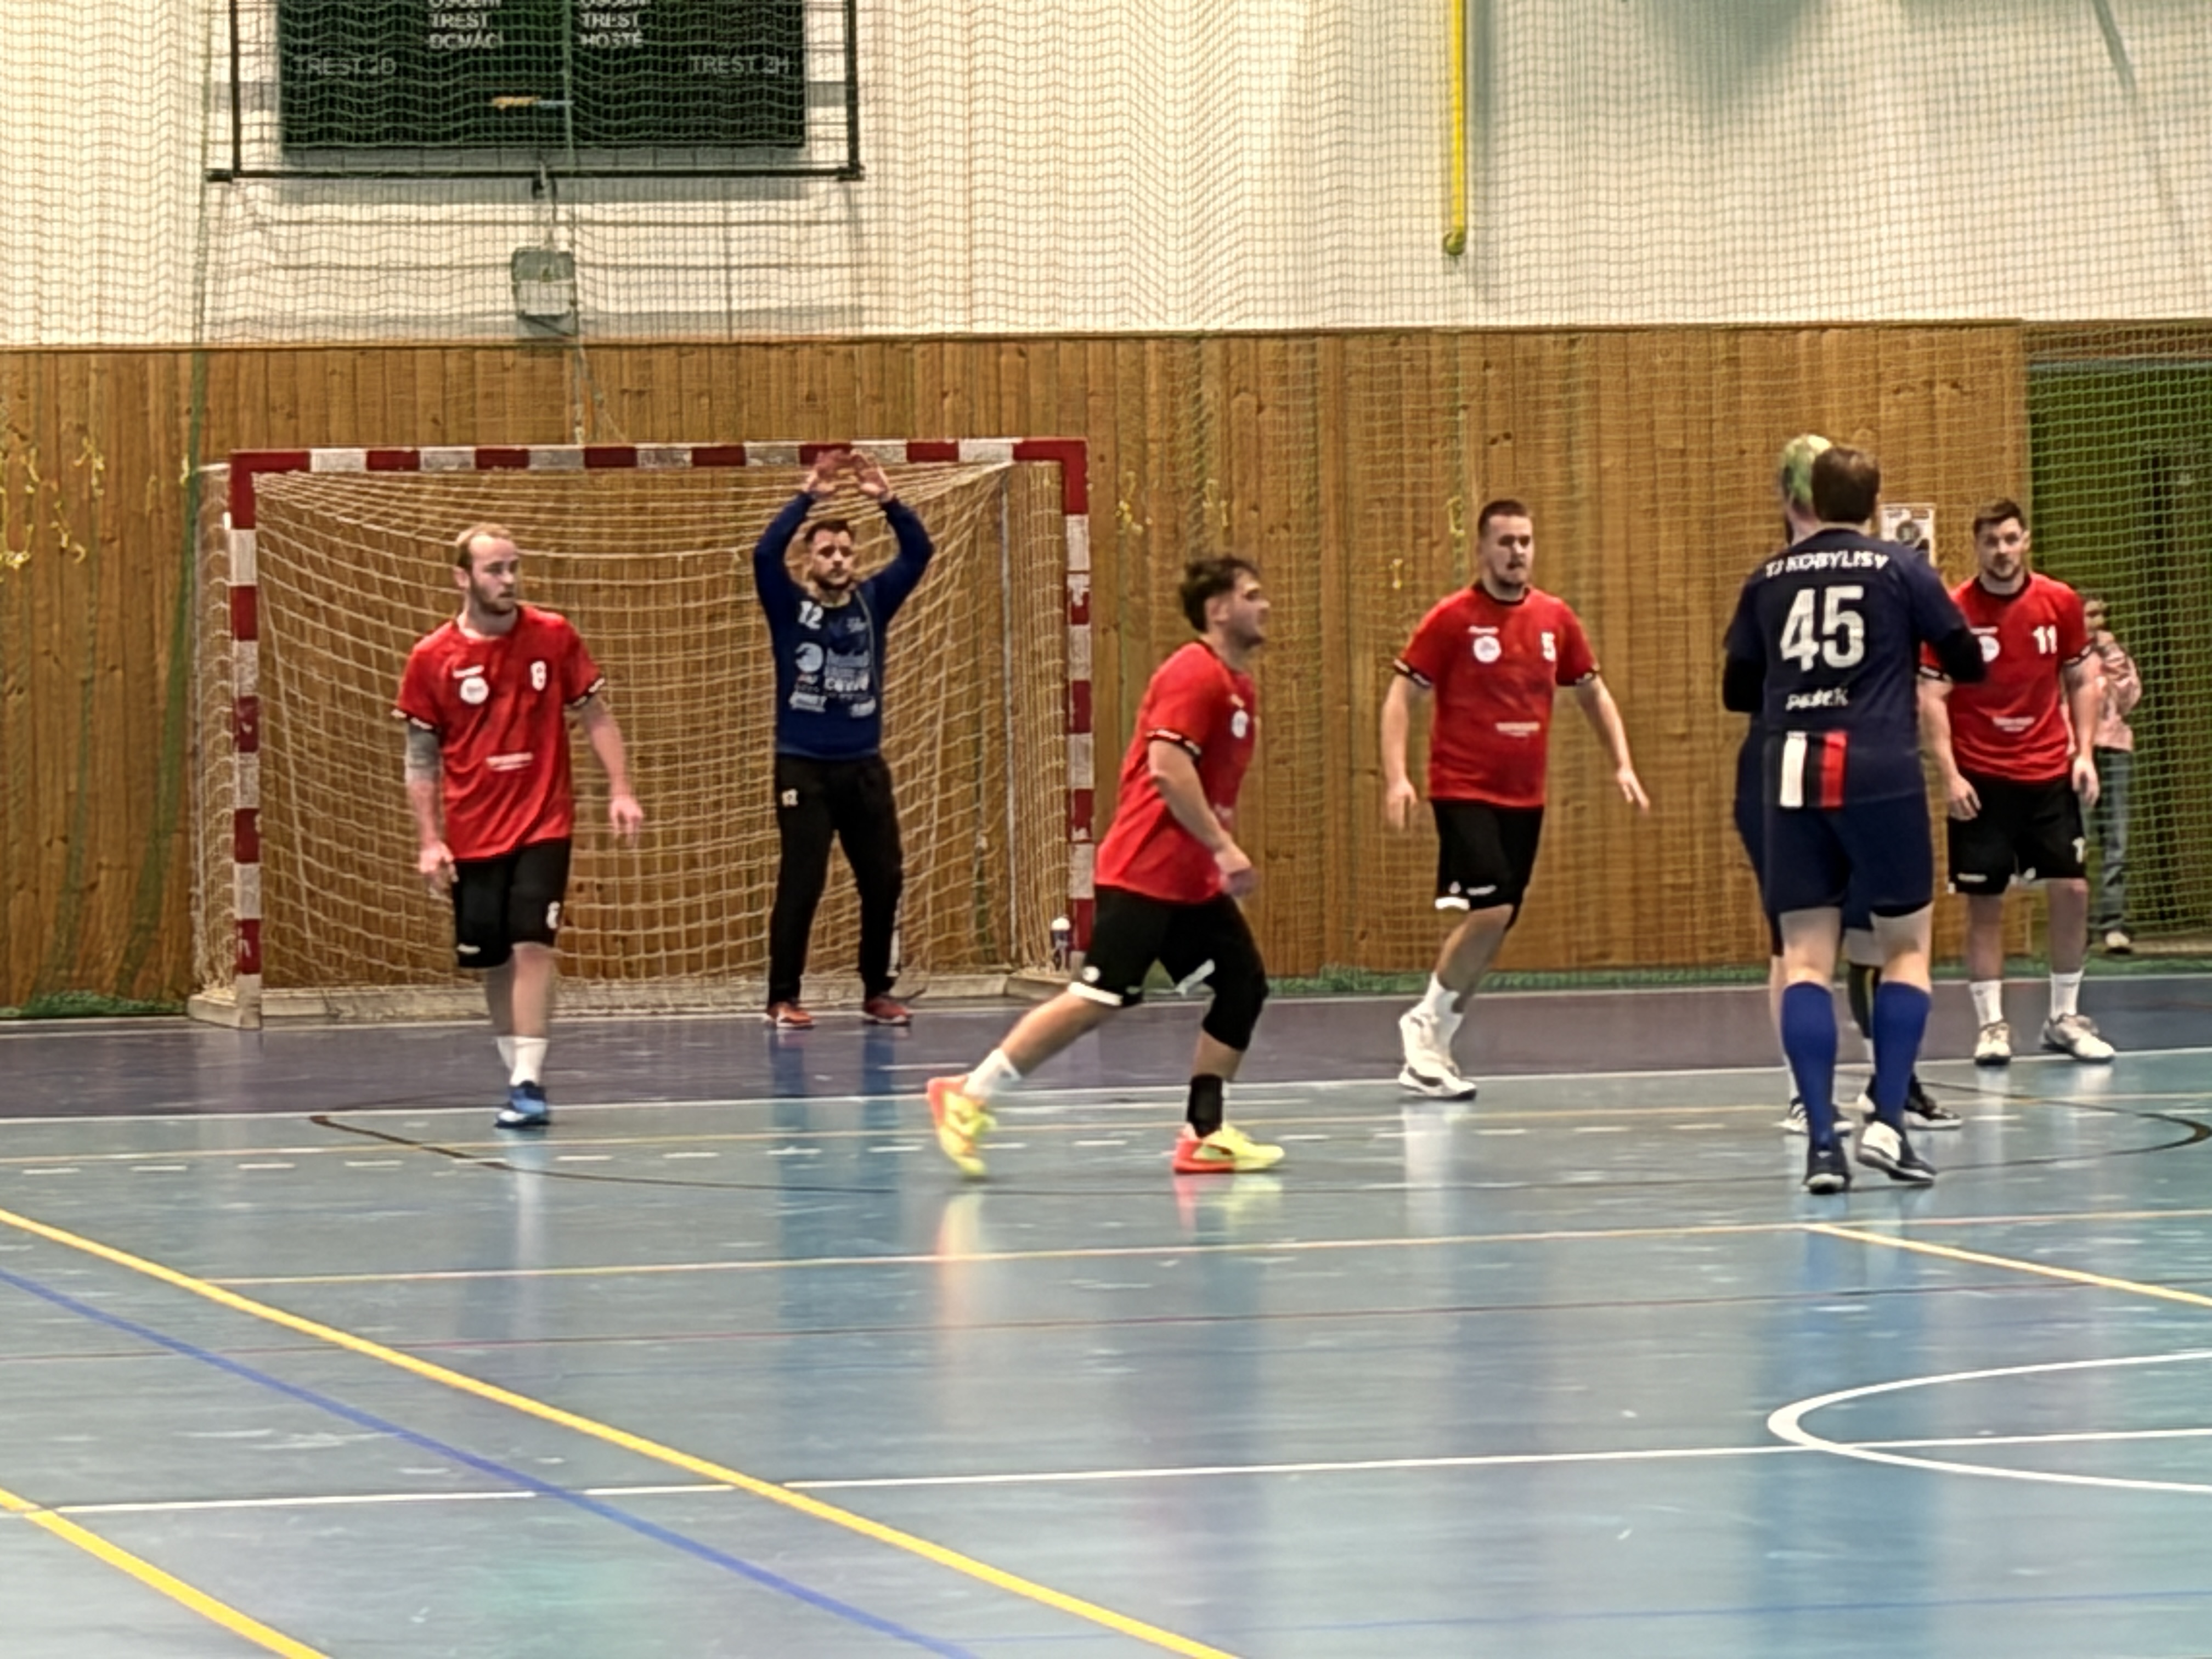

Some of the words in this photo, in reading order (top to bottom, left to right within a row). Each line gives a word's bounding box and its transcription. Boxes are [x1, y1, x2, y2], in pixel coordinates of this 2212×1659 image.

[797, 601, 823, 630] 12
[1780, 585, 1864, 672] 45
[2032, 625, 2057, 654] 11
